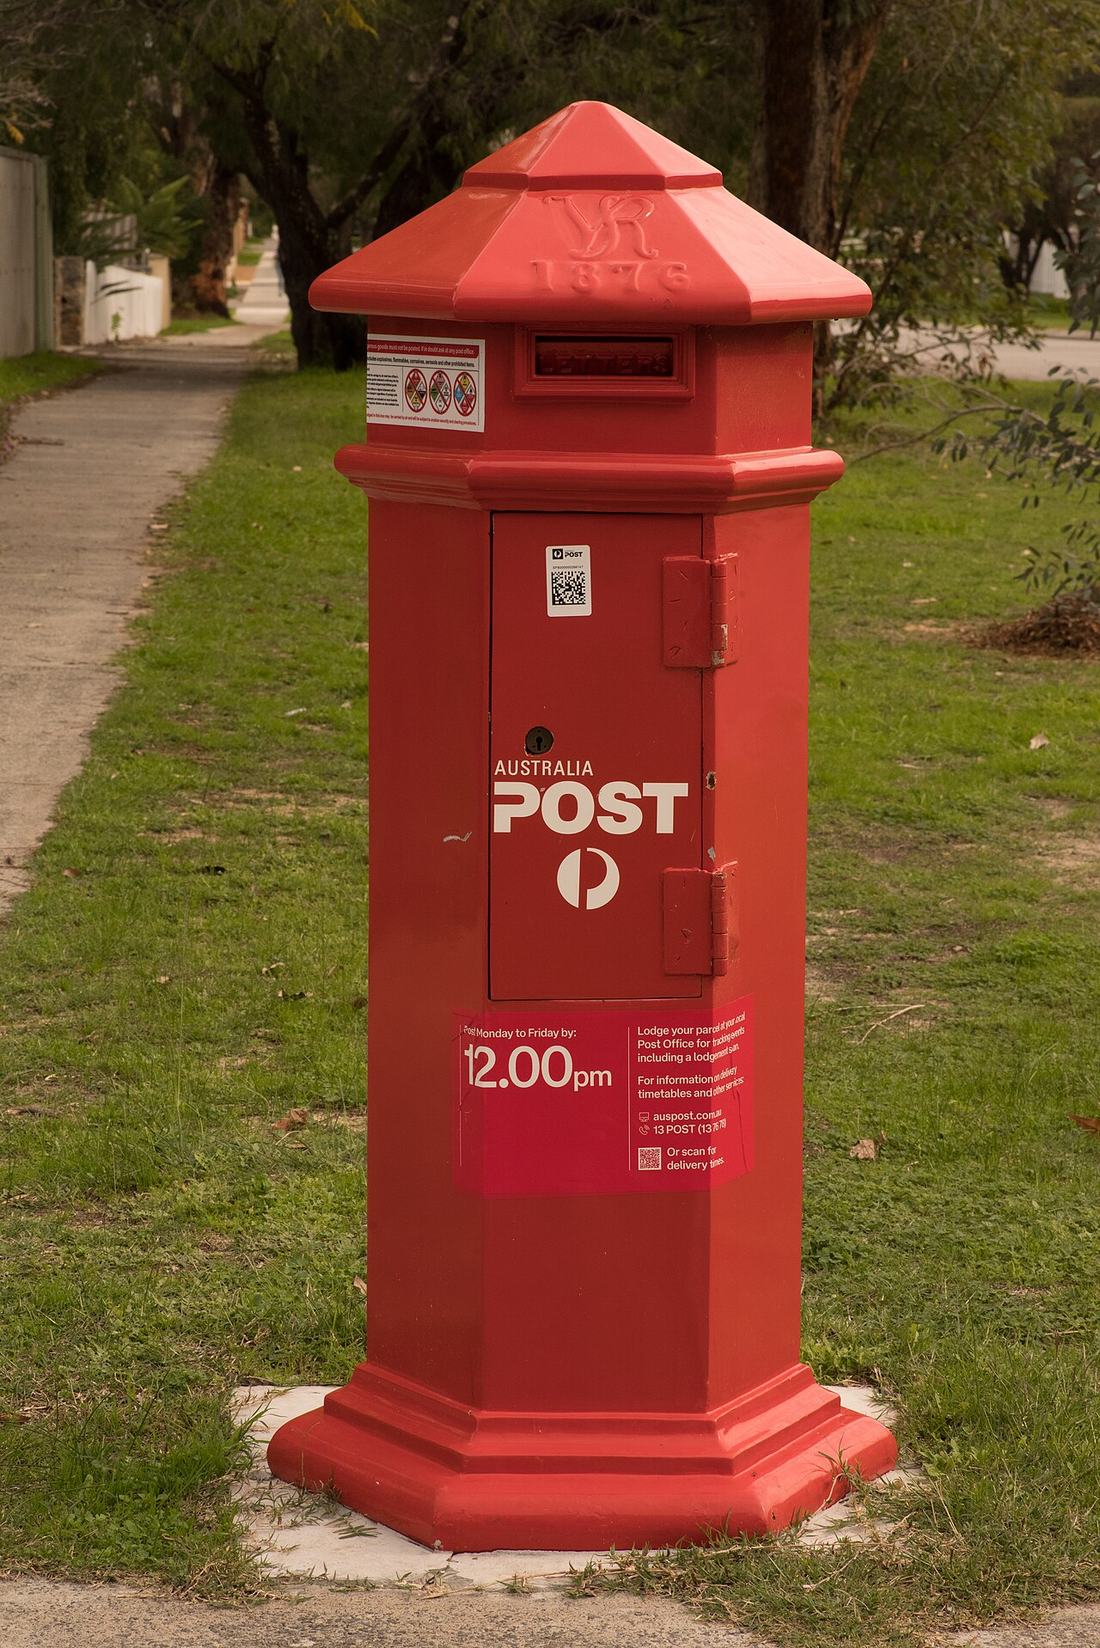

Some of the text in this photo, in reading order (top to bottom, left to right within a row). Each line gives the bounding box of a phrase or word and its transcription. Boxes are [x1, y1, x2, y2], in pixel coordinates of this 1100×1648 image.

[529, 260, 690, 292] 1876
[494, 760, 594, 776] AUSTRALIA
[493, 780, 689, 835] POST
[464, 1025, 577, 1040] Post Monday to Friday by:
[637, 1026, 669, 1037] Lodge
[671, 1027, 694, 1036] your
[695, 1021, 720, 1036] parcel
[724, 1017, 736, 1030] your
[637, 1039, 661, 1049] Post
[662, 1038, 694, 1049] Office
[696, 1038, 710, 1048] for
[712, 1033, 731, 1048] tracking
[637, 1053, 683, 1063] including
[694, 1047, 729, 1062] lodgement
[464, 1043, 612, 1092] 12.00pm
[637, 1066, 738, 1085] For information on delivery
[638, 1089, 692, 1099] timetables
[694, 1087, 713, 1098] and
[712, 1084, 727, 1096] other
[653, 1125, 664, 1134] 13
[666, 1124, 696, 1134] POST
[697, 1123, 712, 1135] (13
[667, 1146, 717, 1156] Or scan for
[667, 1160, 708, 1171] delivery
